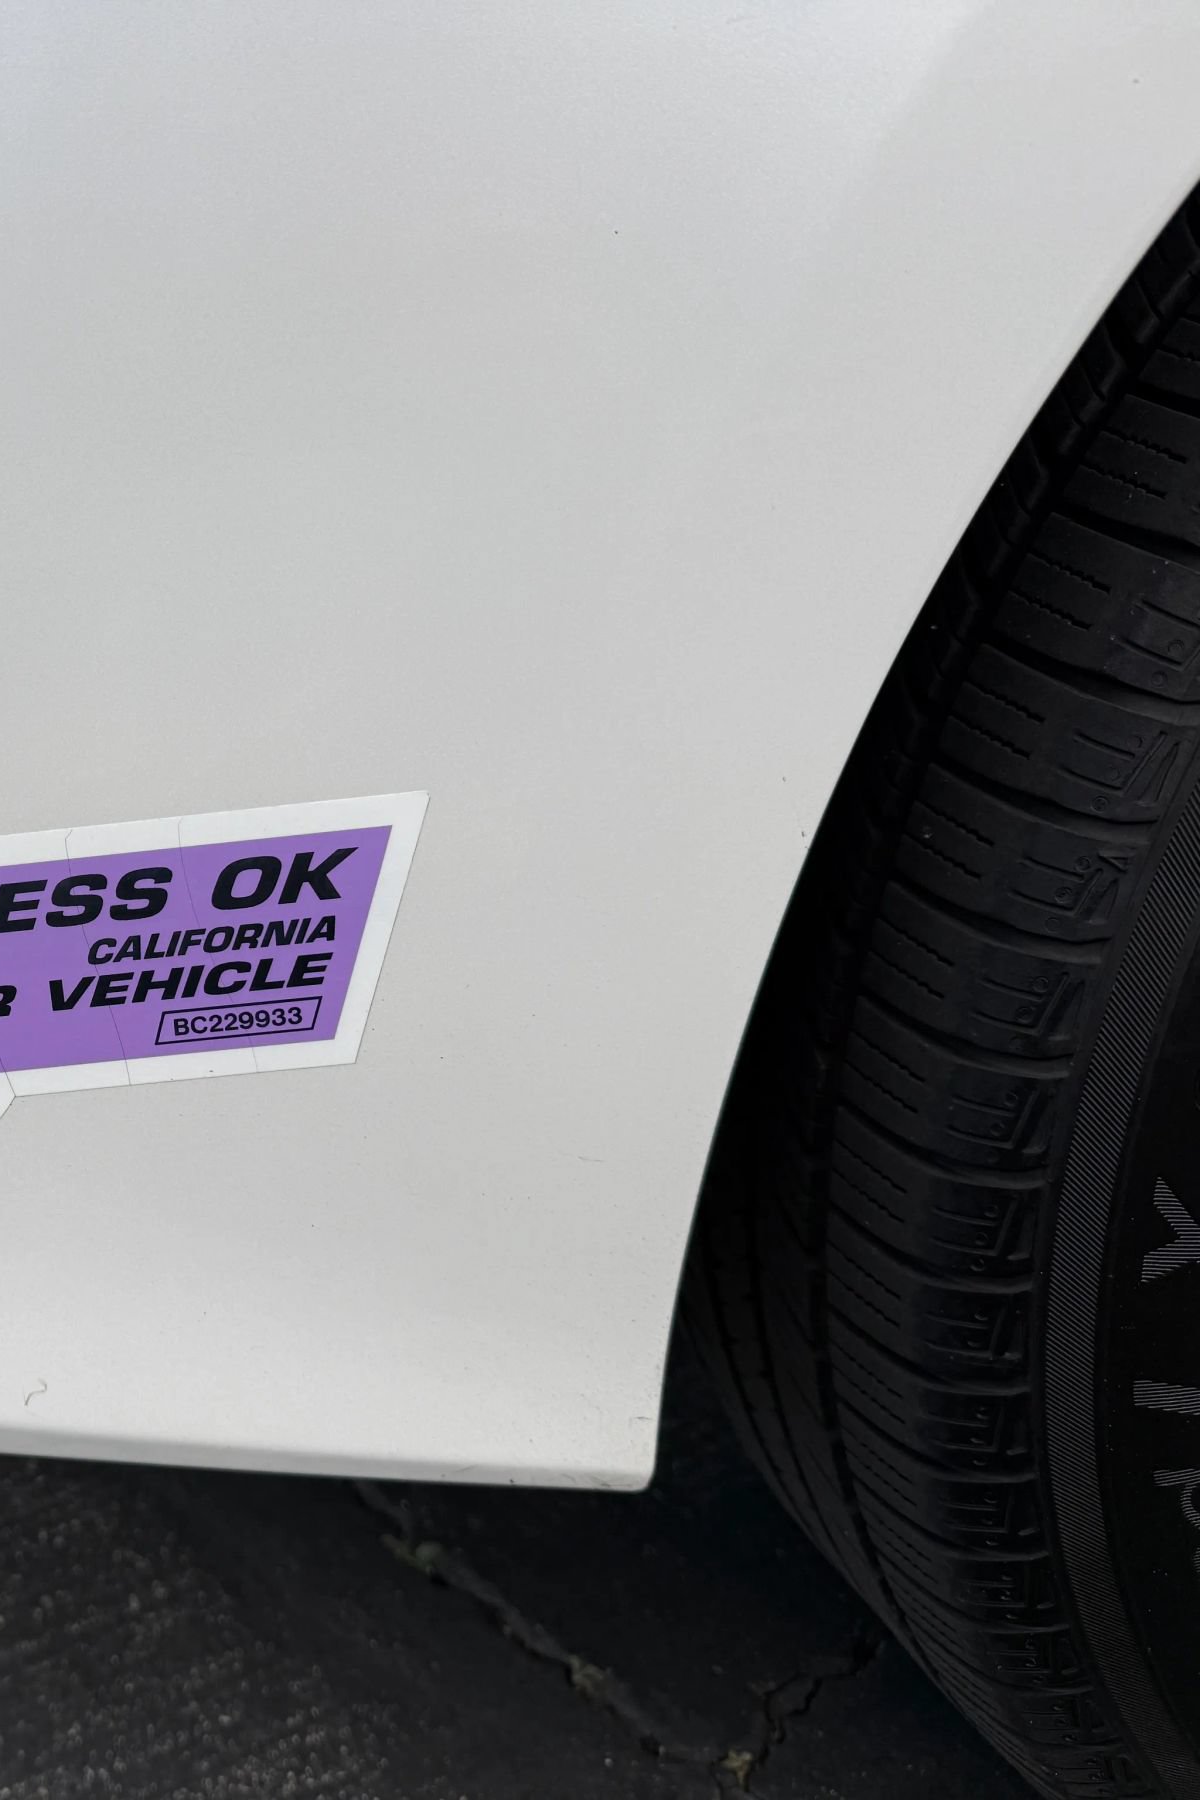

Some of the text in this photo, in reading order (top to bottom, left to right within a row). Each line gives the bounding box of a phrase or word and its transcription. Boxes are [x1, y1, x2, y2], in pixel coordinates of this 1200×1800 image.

[212, 847, 358, 910] OK
[88, 916, 335, 965] CALIFORNIA
[49, 952, 333, 1011] VEHICLE
[174, 1007, 302, 1036] BC229933
